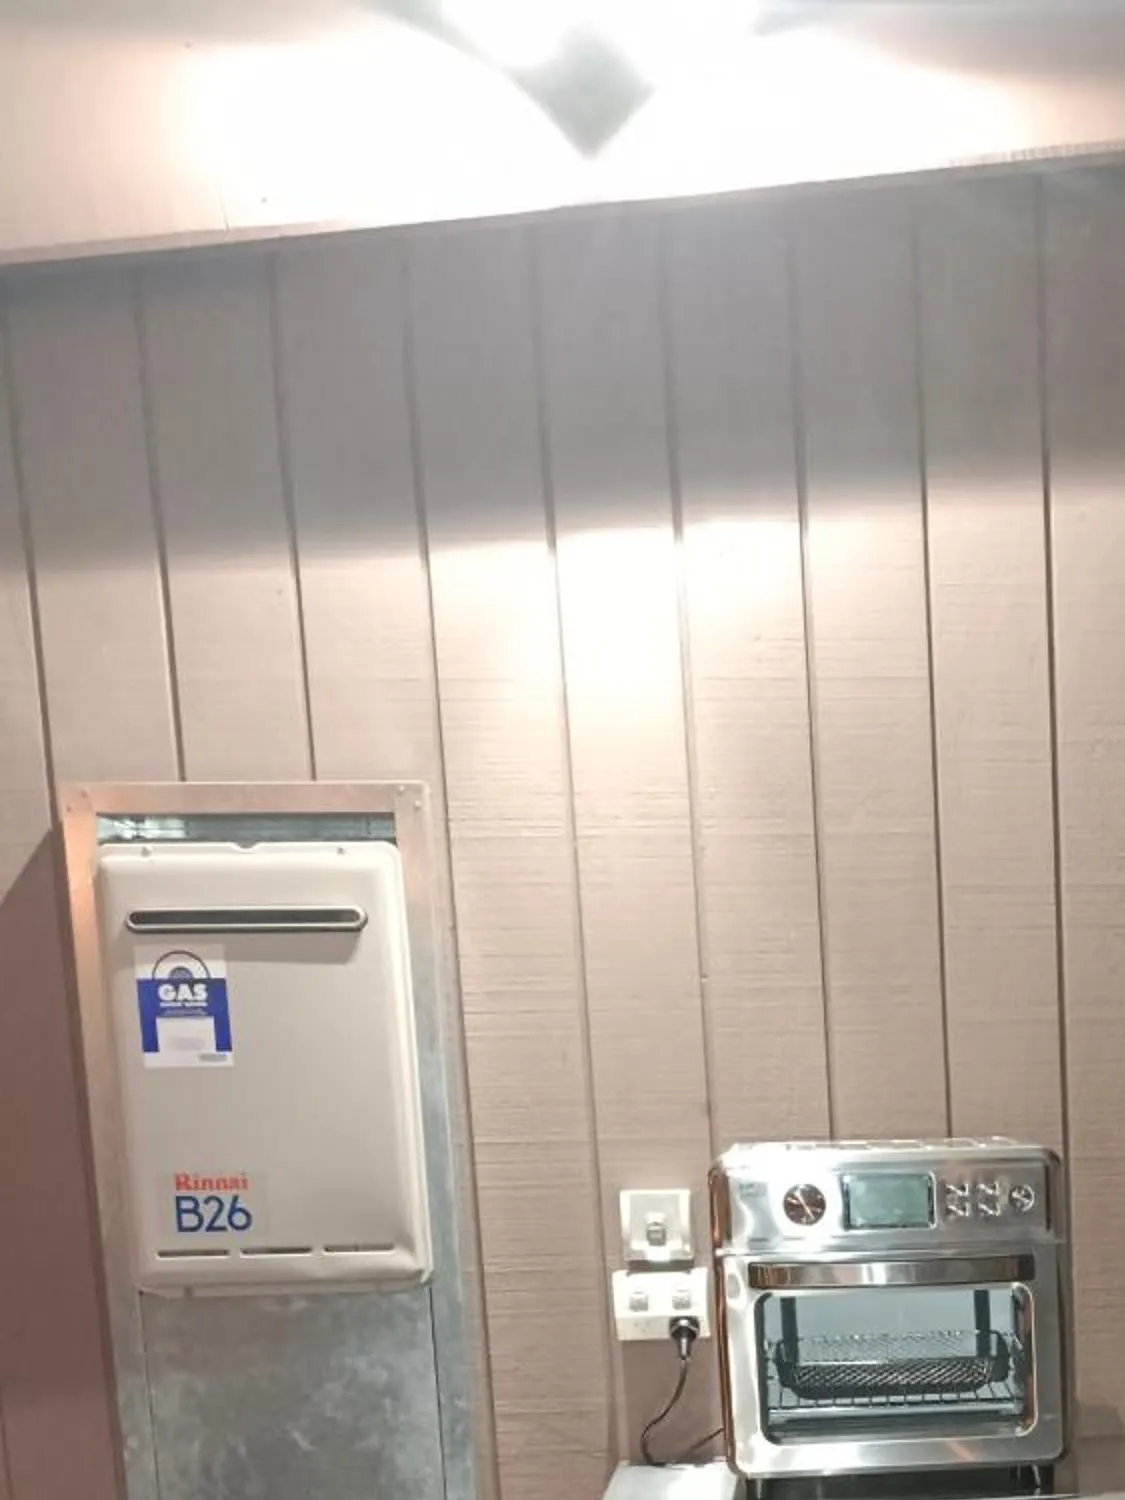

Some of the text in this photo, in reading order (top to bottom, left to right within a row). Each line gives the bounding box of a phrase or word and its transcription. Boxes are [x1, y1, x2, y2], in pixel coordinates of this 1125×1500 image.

[158, 983, 209, 1001] GAS
[174, 1171, 249, 1190] Rinnai
[175, 1194, 253, 1232] B26
